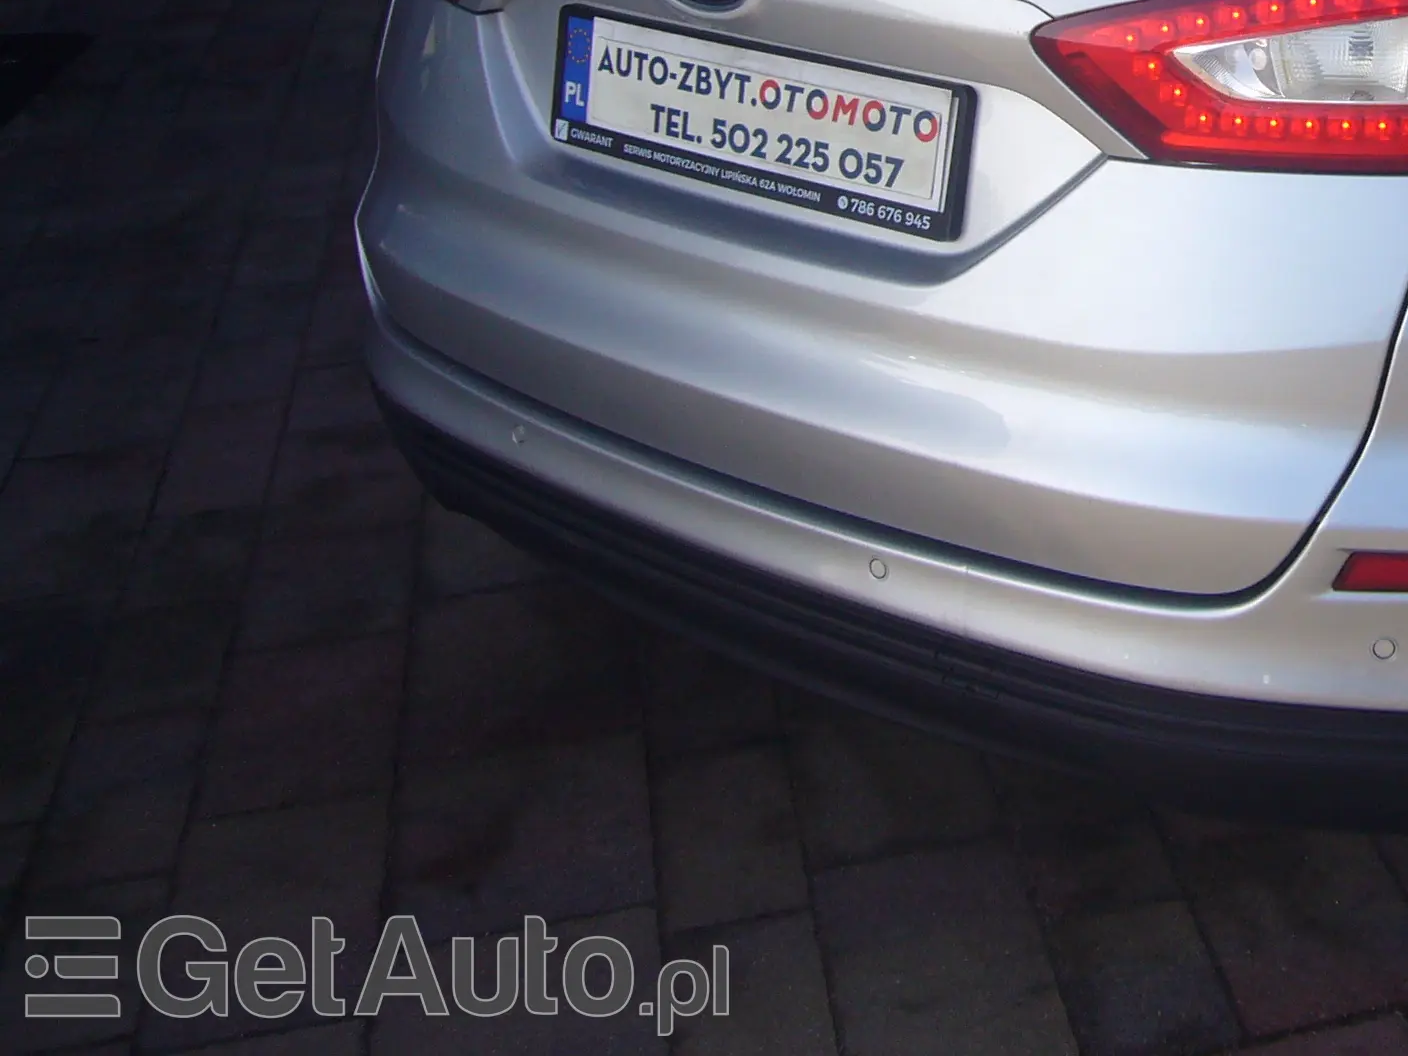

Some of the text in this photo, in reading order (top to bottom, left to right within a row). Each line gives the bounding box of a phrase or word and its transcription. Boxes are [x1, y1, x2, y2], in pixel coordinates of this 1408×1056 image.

[564, 80, 585, 107] PL
[597, 45, 939, 143] AUTO-ZBYT.OTOMOTO
[623, 143, 653, 160] SERWIS
[653, 151, 721, 178] MOTORYZACYJNY
[650, 103, 905, 188] TEL. 502 225 057
[850, 198, 931, 231] 786 676 945
